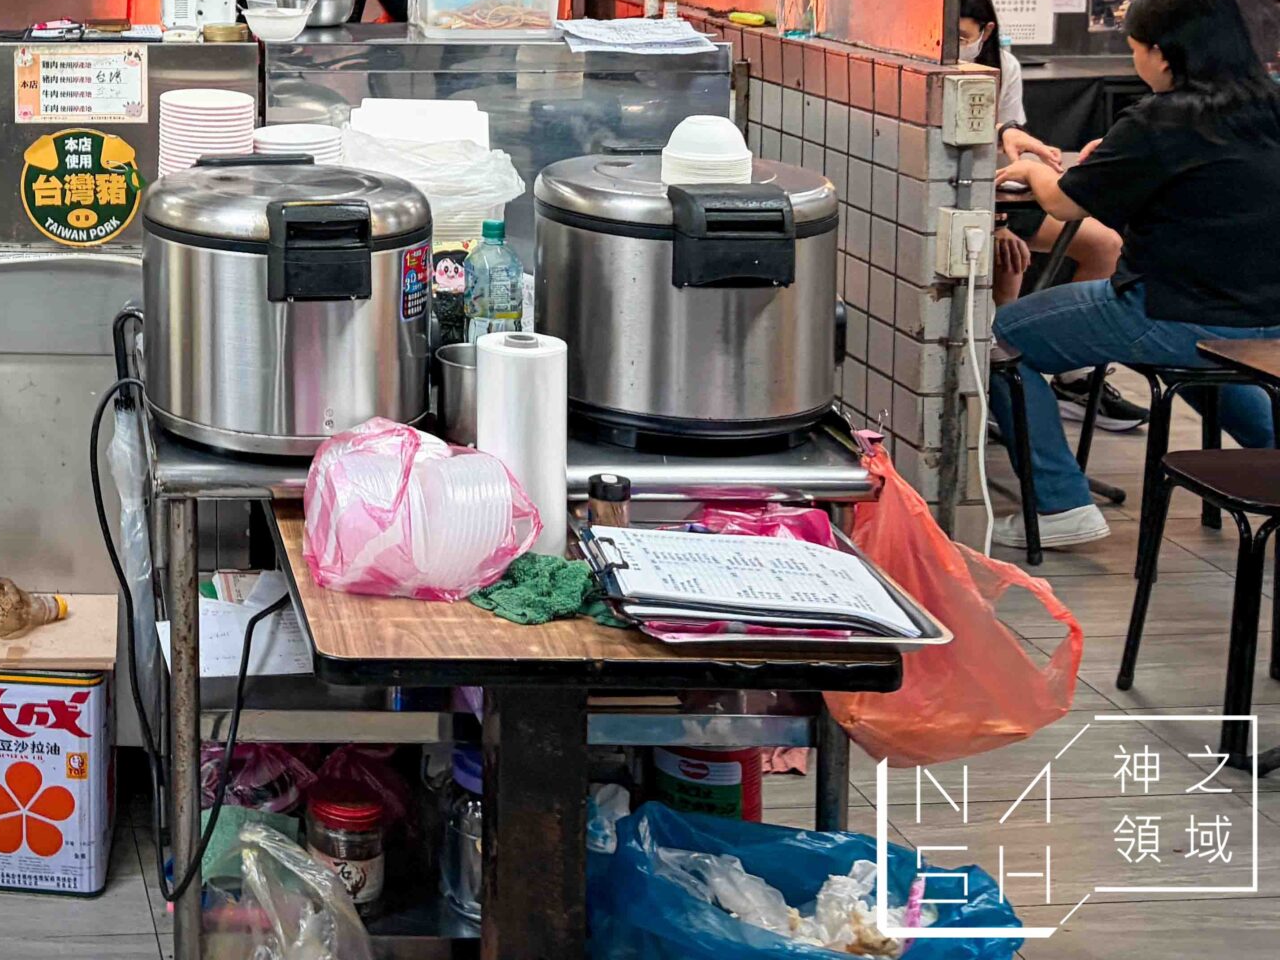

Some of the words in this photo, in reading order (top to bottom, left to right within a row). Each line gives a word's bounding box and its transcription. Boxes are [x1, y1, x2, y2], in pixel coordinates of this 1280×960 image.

[64, 136, 93, 153] 本店
[64, 154, 93, 169] 使用
[32, 172, 128, 207] 台灣豬
[44, 216, 87, 241] TAIWAN
[89, 215, 121, 240] PORK
